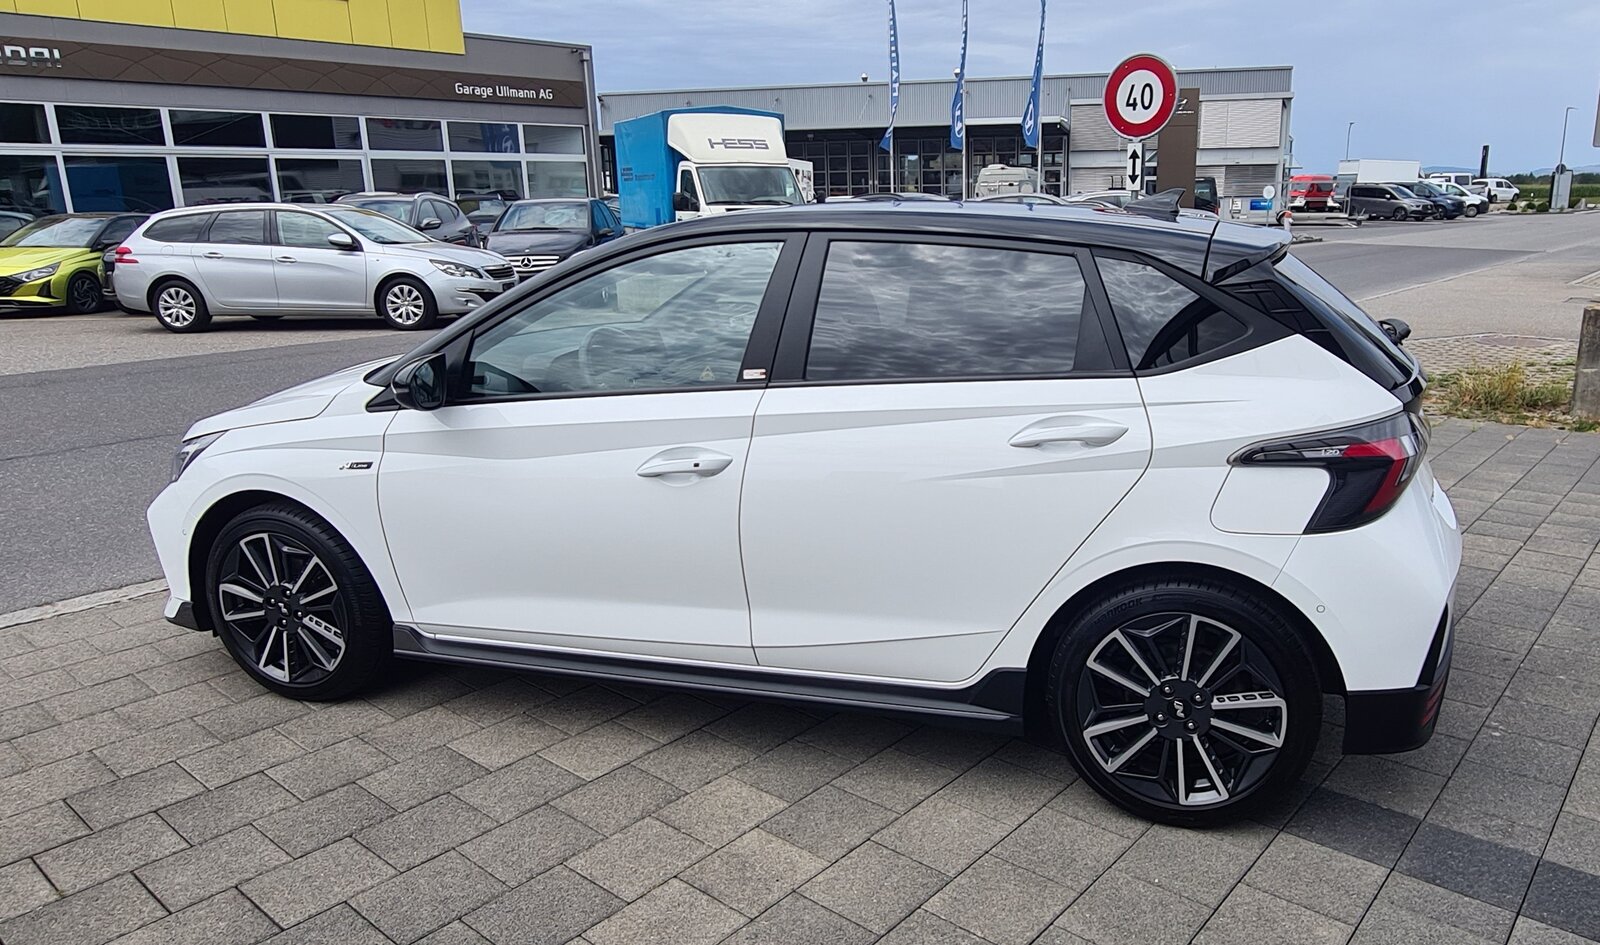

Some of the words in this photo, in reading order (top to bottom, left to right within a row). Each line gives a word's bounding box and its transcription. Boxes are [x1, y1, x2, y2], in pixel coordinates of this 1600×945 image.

[0, 45, 62, 68] DAI
[455, 82, 493, 98] Garage
[496, 85, 536, 98] Ullmann
[539, 88, 553, 100] AG
[1126, 82, 1153, 111] 40
[708, 138, 769, 149] HESS
